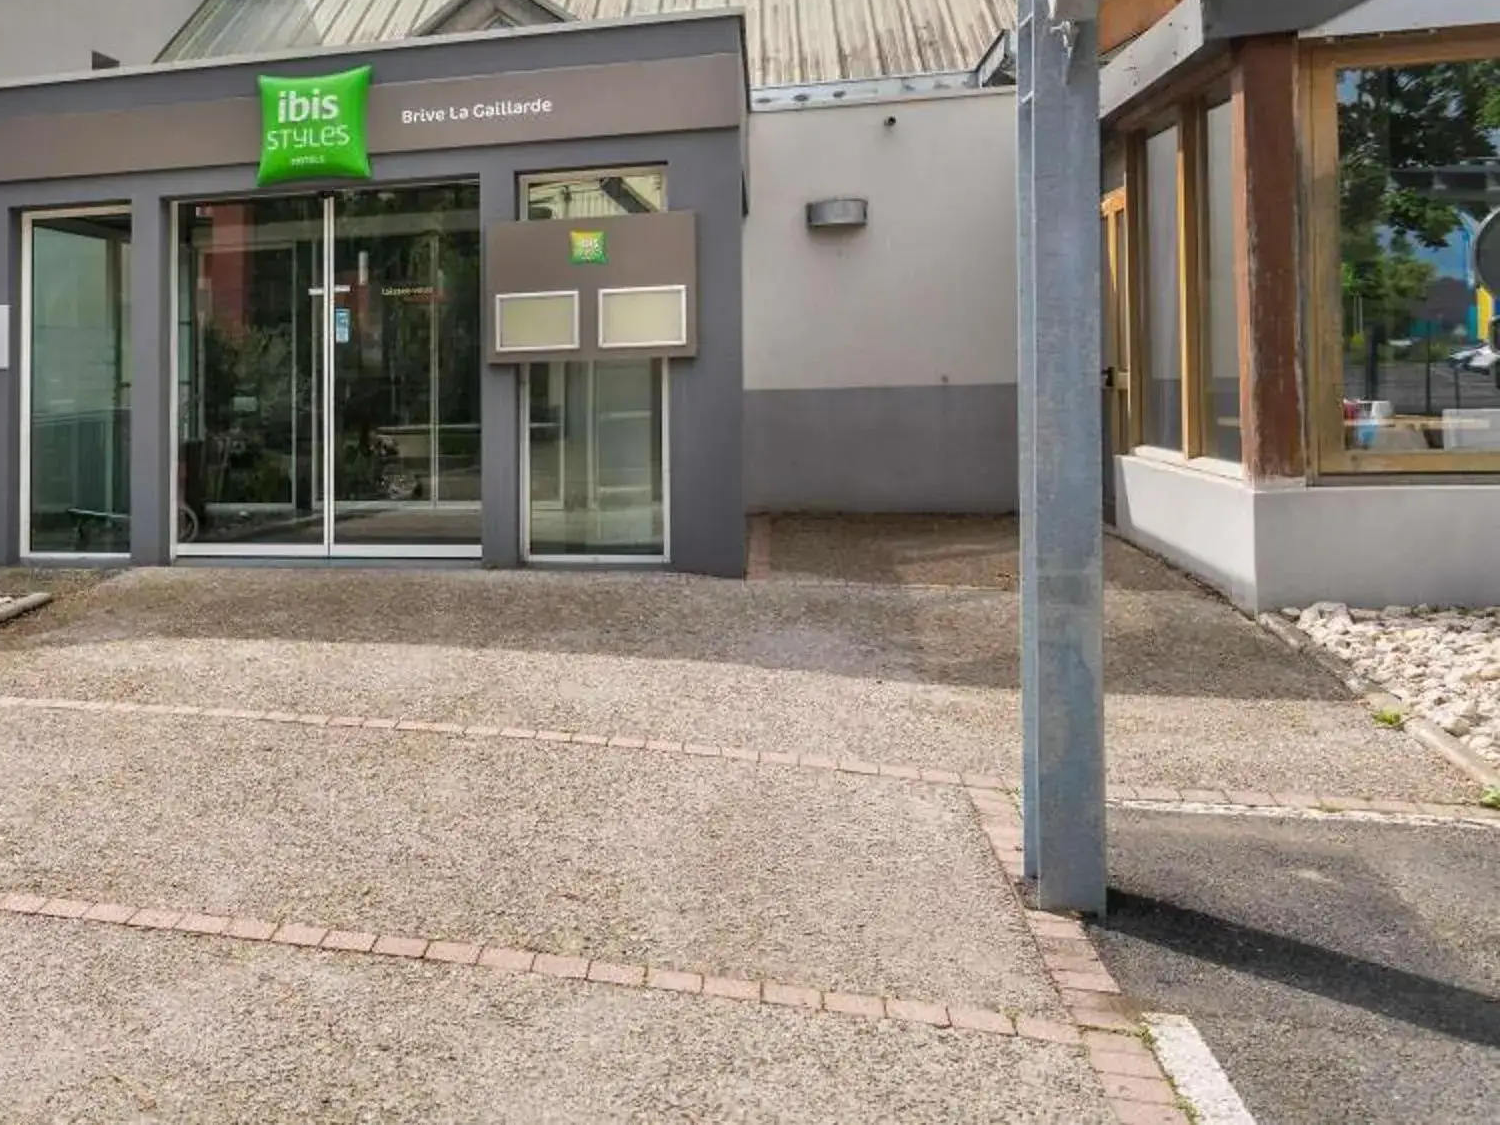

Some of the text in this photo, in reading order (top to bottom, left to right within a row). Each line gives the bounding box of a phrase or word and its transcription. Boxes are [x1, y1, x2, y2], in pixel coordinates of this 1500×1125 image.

[277, 88, 339, 124] ibis
[401, 98, 553, 124] Brive La Gaillarde
